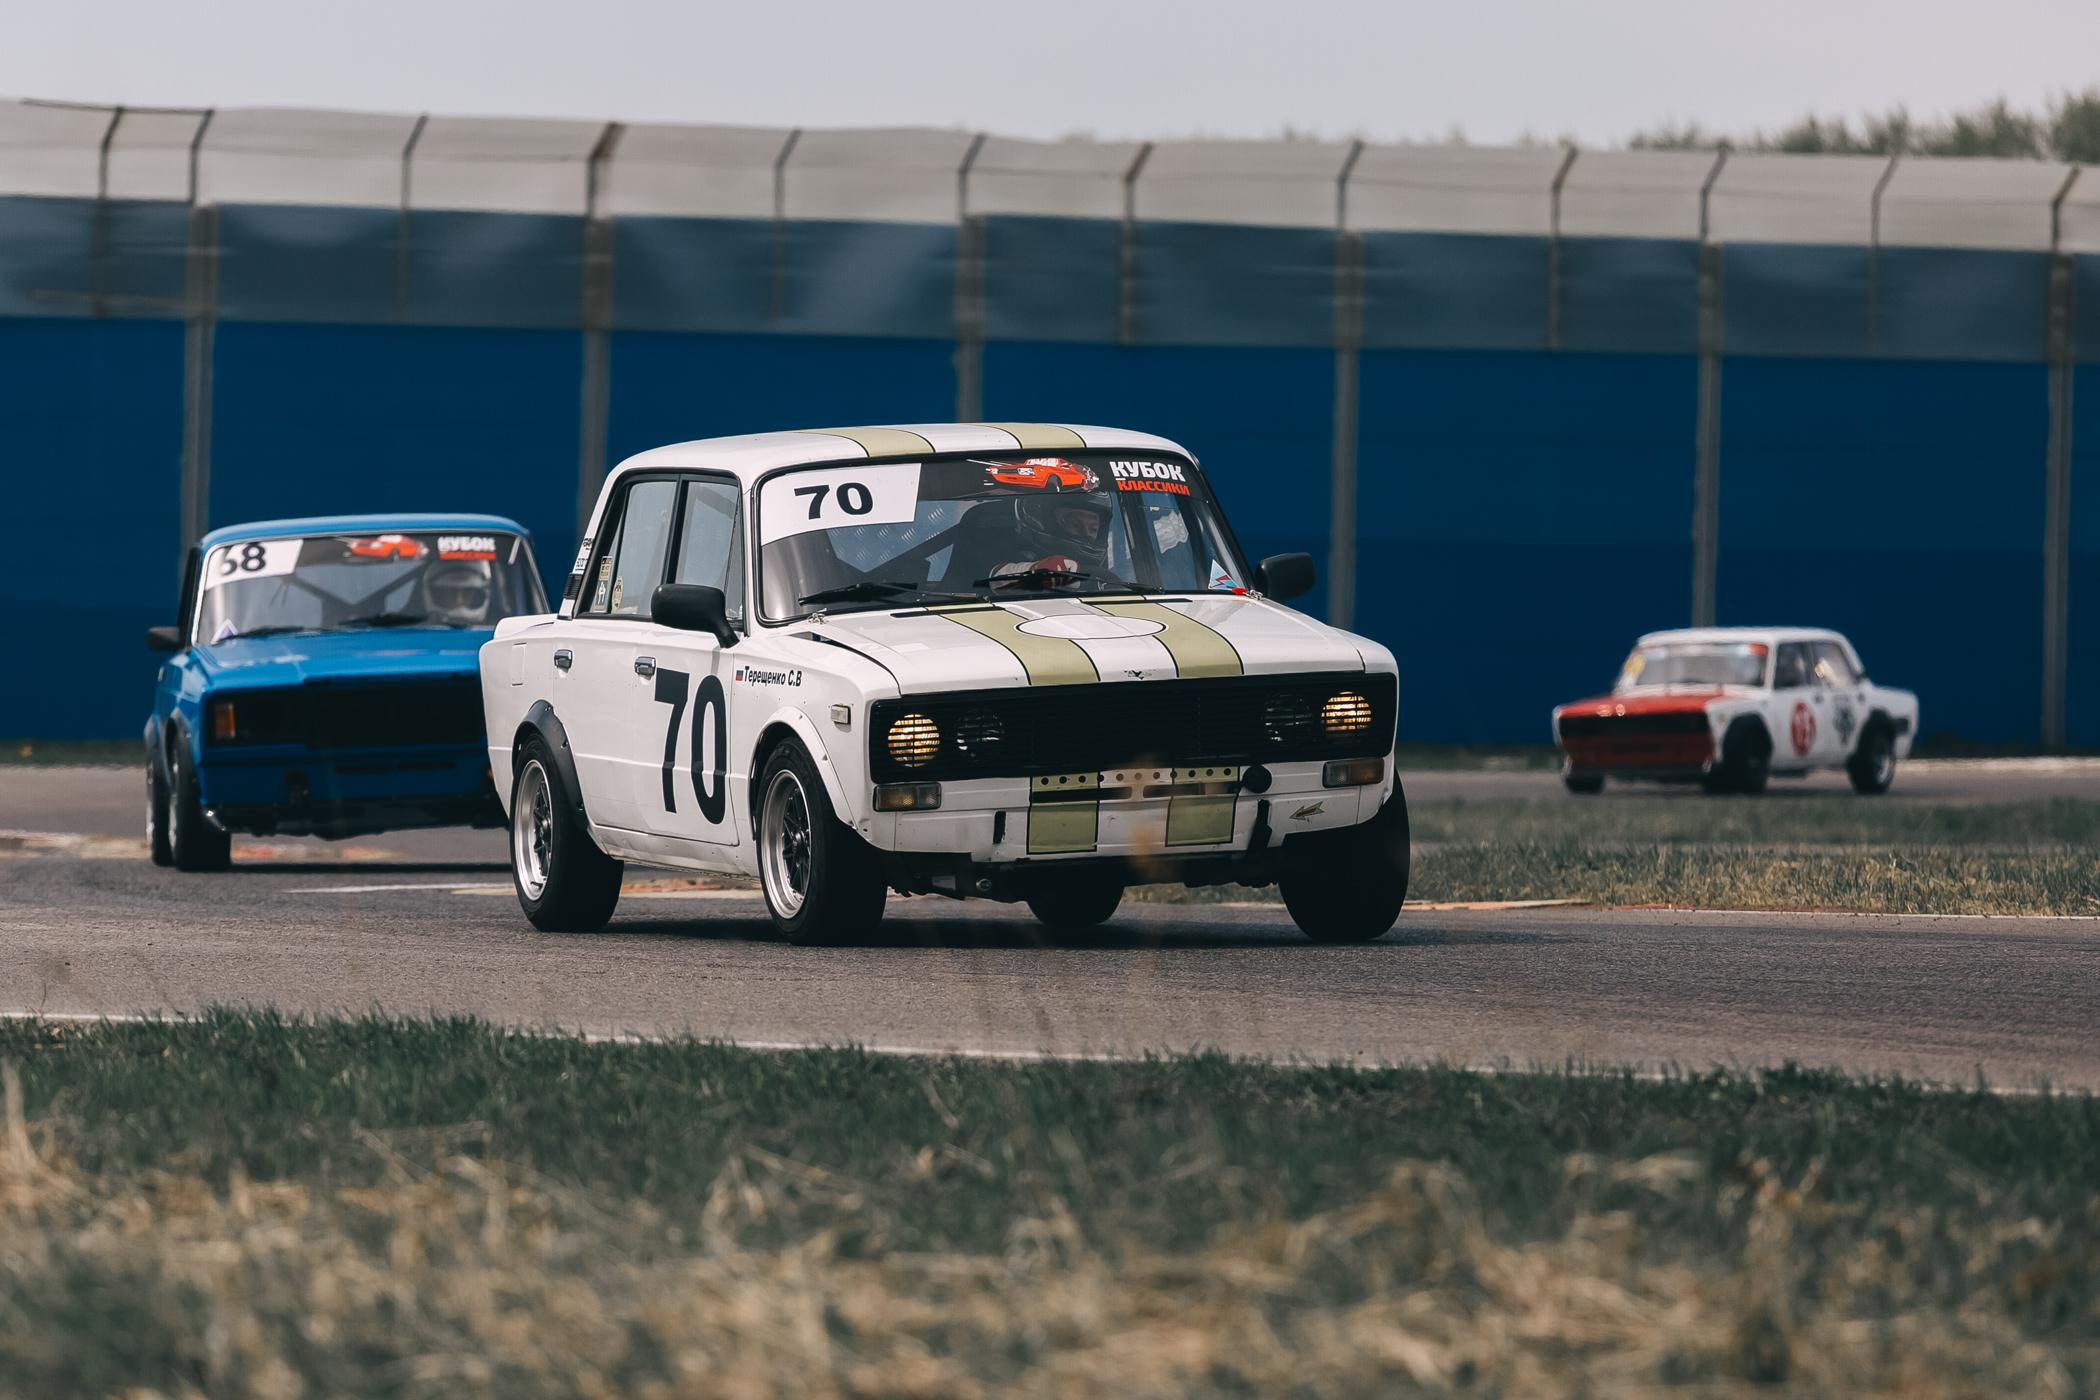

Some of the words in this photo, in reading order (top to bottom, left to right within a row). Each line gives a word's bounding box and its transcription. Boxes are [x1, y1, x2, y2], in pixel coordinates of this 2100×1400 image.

[1109, 461, 1186, 482] КУБОК
[1116, 479, 1191, 496] КЛАССИКИ
[794, 482, 873, 520] 70
[744, 666, 786, 686] Терещенко
[654, 668, 727, 825] 70
